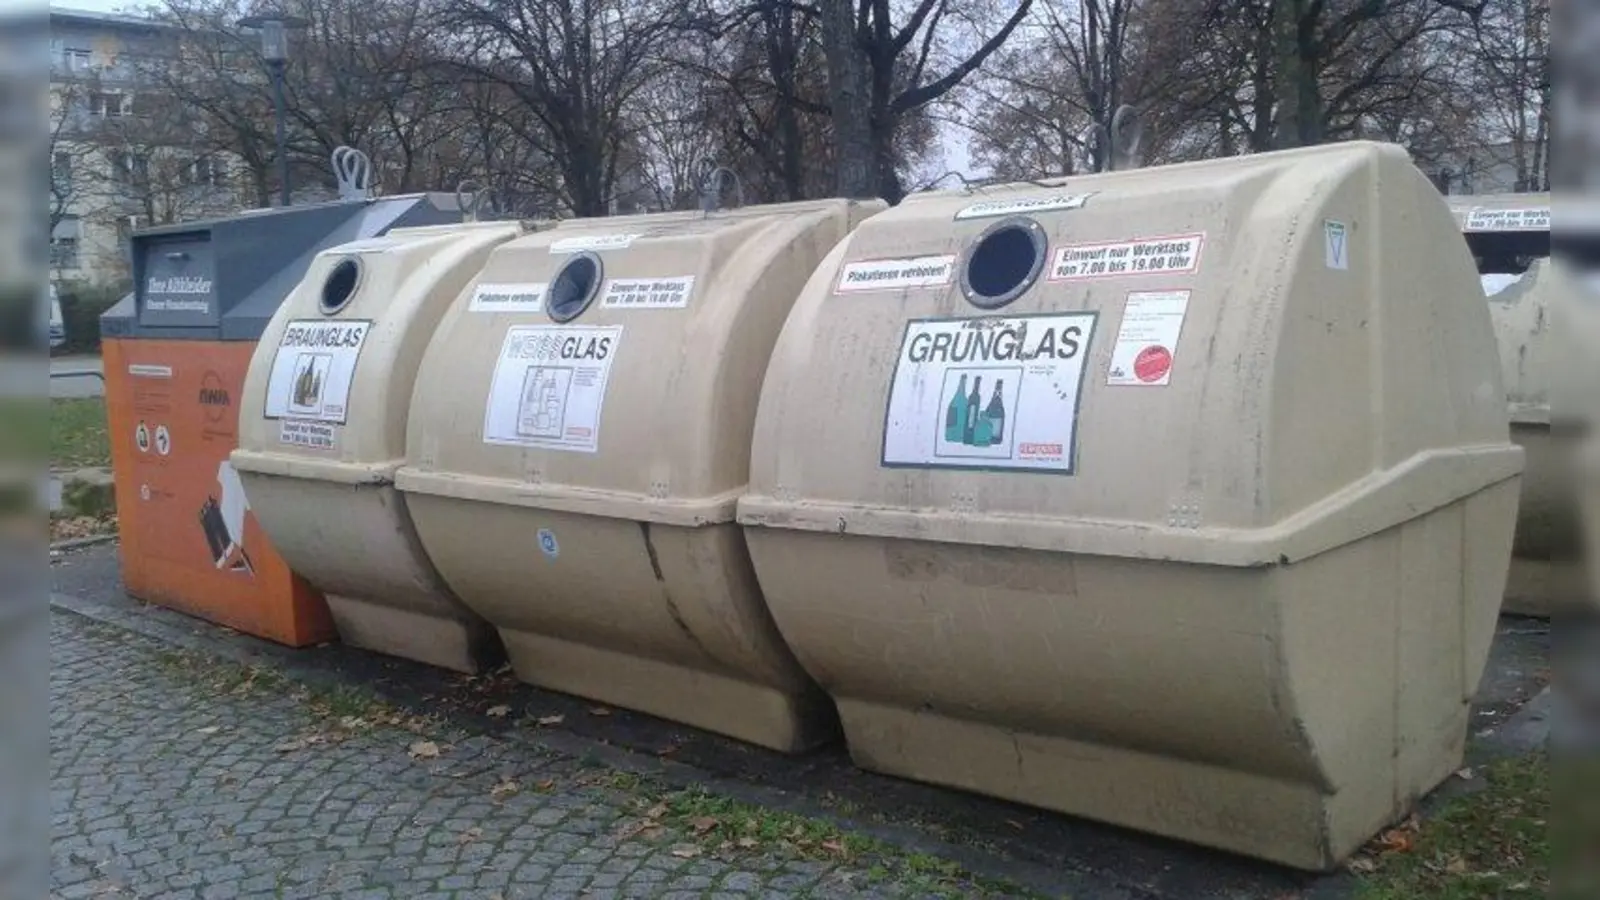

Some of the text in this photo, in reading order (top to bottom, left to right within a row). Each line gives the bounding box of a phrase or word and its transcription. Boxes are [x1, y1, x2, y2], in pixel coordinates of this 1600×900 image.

[1062, 242, 1190, 262] Einwurf nur Werktags
[1056, 254, 1190, 276] von 7.00 bis 19.00 Uhr
[846, 269, 900, 283] Plakatieren
[283, 327, 362, 348] BRAUNGLAS
